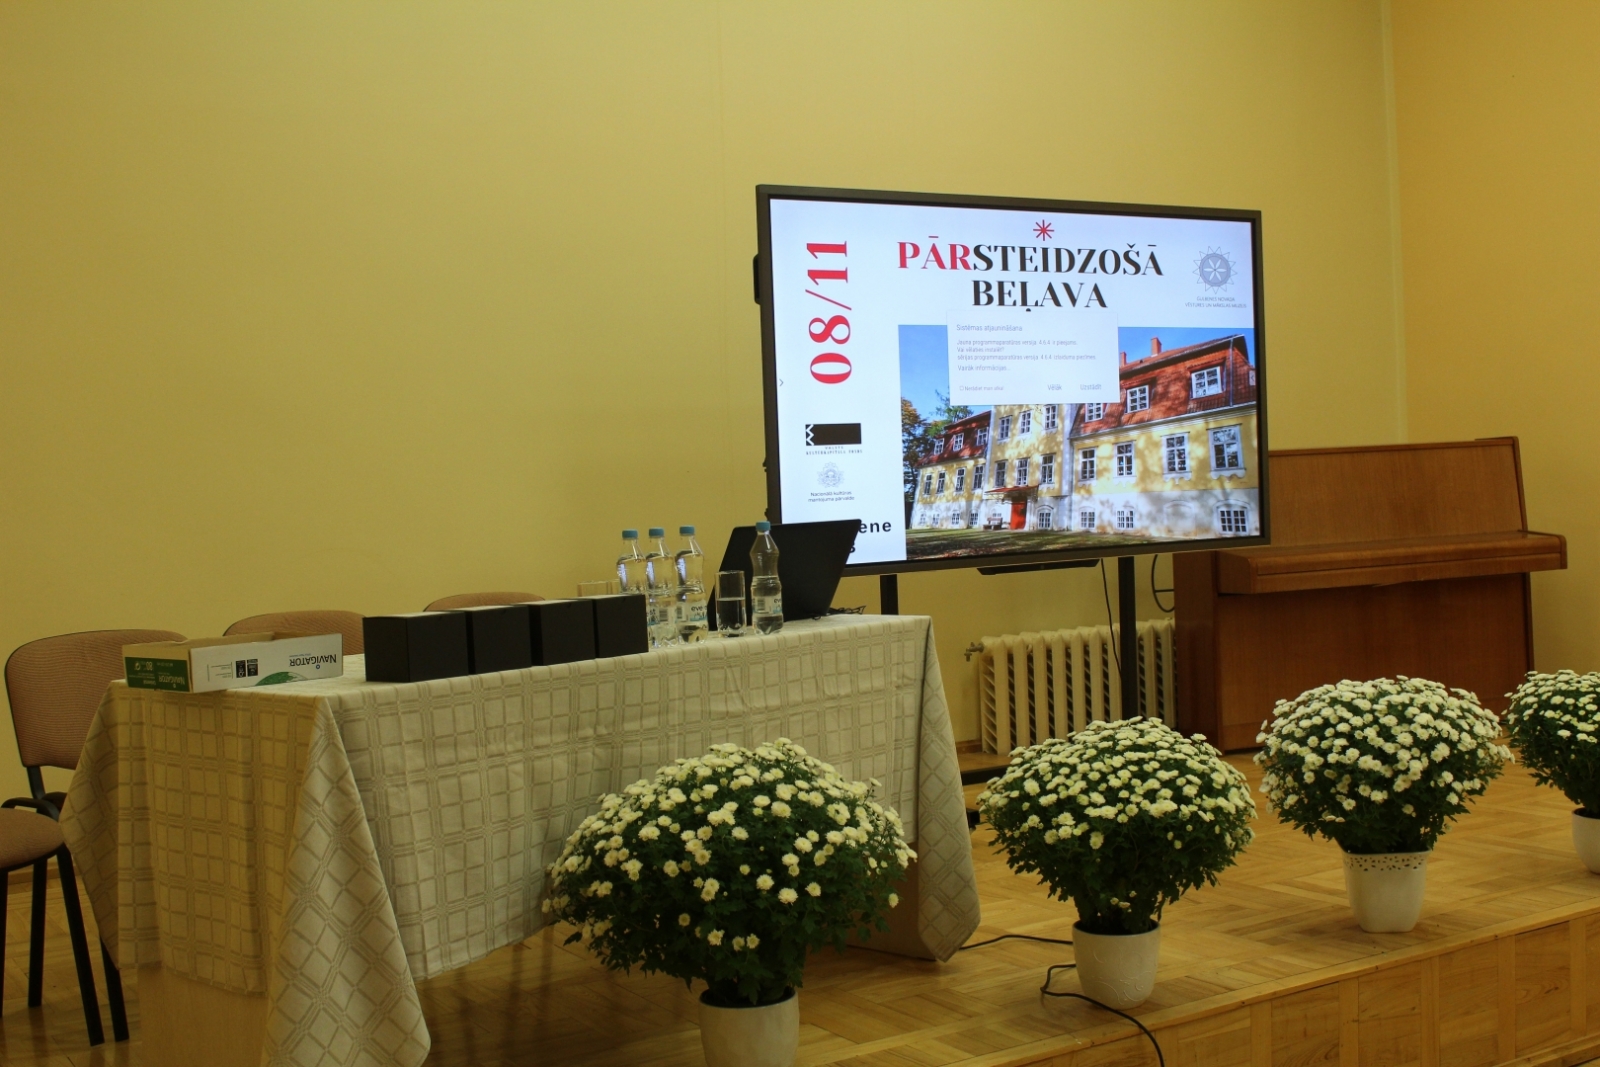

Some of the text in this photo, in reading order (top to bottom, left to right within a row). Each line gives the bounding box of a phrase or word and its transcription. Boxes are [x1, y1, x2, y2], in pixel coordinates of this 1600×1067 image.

[897, 236, 1164, 276] PĀRSTEIDZOŠĀ
[972, 280, 1108, 312] BEĻAVA
[805, 241, 852, 385] 08/11
[956, 324, 983, 332] Sistēmas
[1047, 383, 1062, 391] Vēlāk
[289, 654, 337, 669] NAVIGATOR
